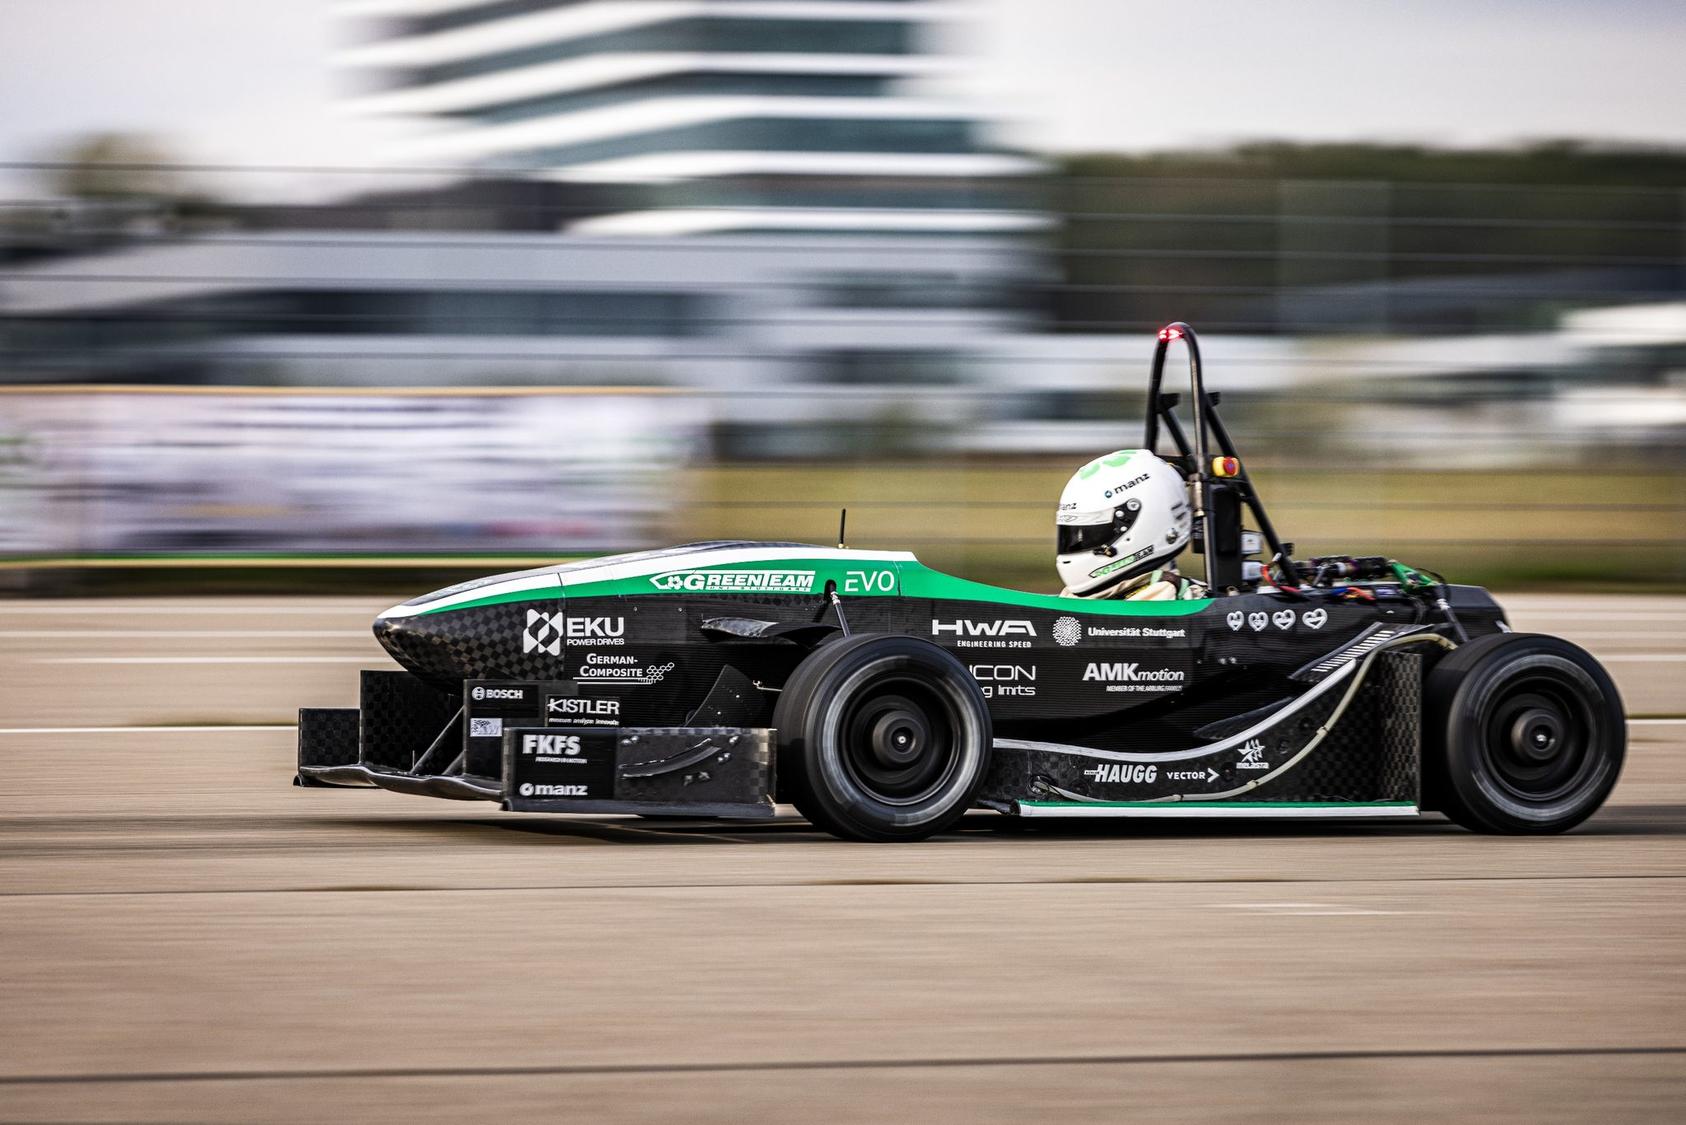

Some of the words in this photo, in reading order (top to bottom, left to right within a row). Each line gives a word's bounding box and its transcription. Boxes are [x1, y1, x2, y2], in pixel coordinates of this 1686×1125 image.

[1114, 473, 1150, 494] manz
[845, 571, 895, 592] EVO
[566, 617, 625, 637] EKU
[932, 619, 1037, 636] HWA
[1088, 627, 1141, 637] Universität
[1143, 628, 1186, 639] Stuttgart
[566, 638, 596, 646] POWER
[597, 638, 625, 646] DRIVES
[1009, 640, 1032, 648] SPEED
[486, 689, 524, 700] BOSCH
[547, 698, 620, 715] KISTLER
[522, 734, 581, 756] FKFS
[1094, 764, 1158, 783] HAUGG
[1166, 771, 1206, 780] VECTOR
[535, 784, 588, 796] manz
